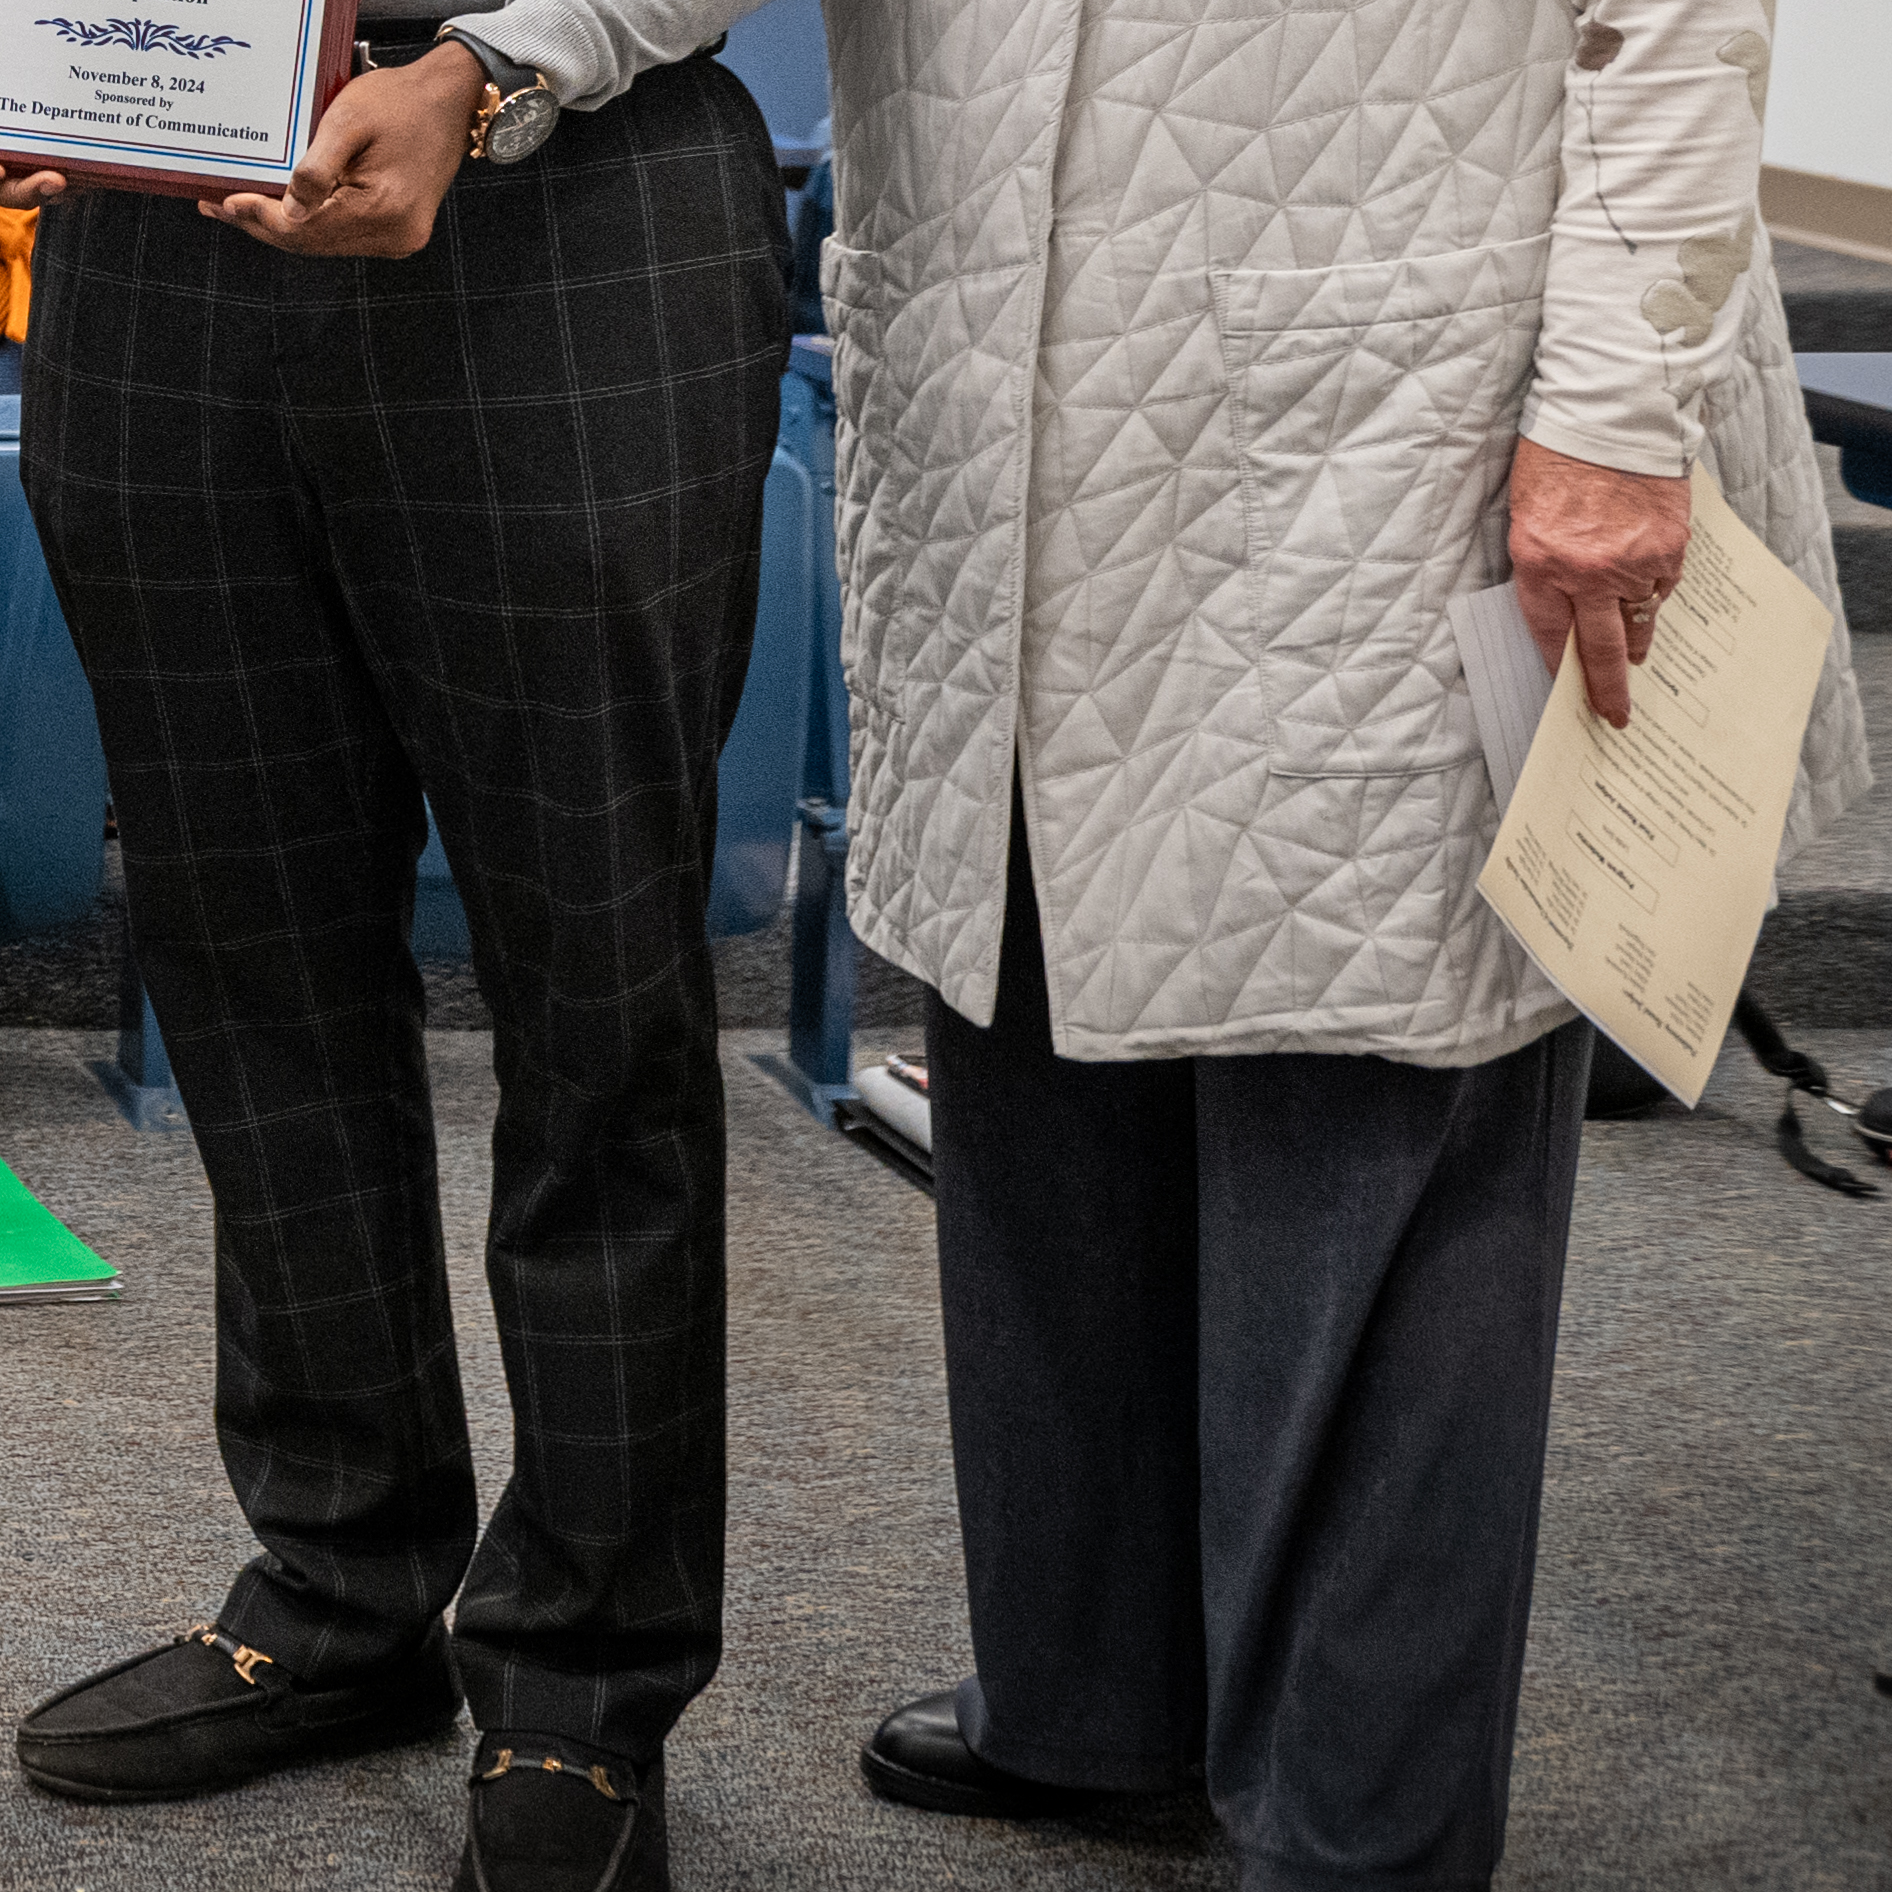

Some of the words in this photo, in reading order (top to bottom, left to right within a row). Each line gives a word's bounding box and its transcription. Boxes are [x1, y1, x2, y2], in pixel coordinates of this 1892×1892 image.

[69, 65, 148, 87] November
[150, 74, 164, 91] 8,
[168, 76, 205, 94] 2024
[94, 89, 156, 107] Sponsored
[158, 96, 174, 112] by
[31, 100, 122, 125] Department
[125, 113, 144, 127] of
[145, 114, 269, 142] Communication
